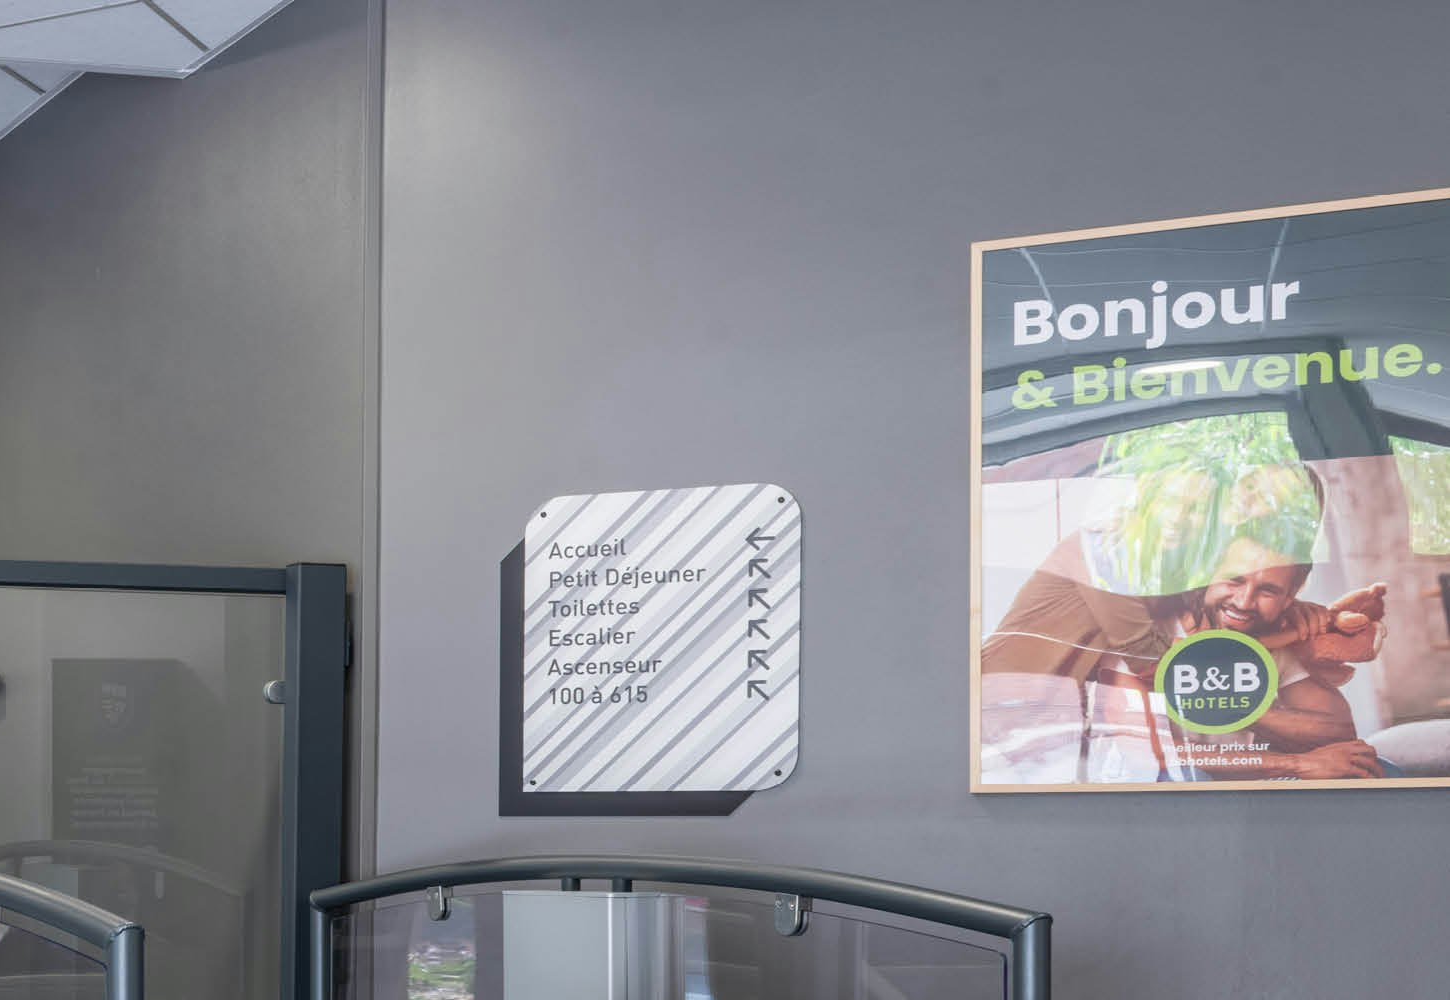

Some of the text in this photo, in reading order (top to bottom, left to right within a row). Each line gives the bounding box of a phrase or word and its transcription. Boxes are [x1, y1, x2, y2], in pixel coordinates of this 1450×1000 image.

[1013, 280, 1299, 349] Bonjour
[1011, 343, 1443, 410] & Bienvenue.
[548, 539, 627, 560] Accueil
[549, 567, 706, 589] Petit Déjeuner
[548, 598, 640, 618] Toilettes
[549, 628, 636, 647] Escalier
[547, 658, 662, 677] Ascenseur
[1173, 662, 1261, 694] B&B
[549, 685, 648, 705] 100 à 615
[1181, 696, 1250, 709] HOTELS
[1220, 742, 1246, 754] prix
[1247, 742, 1270, 752] sur
